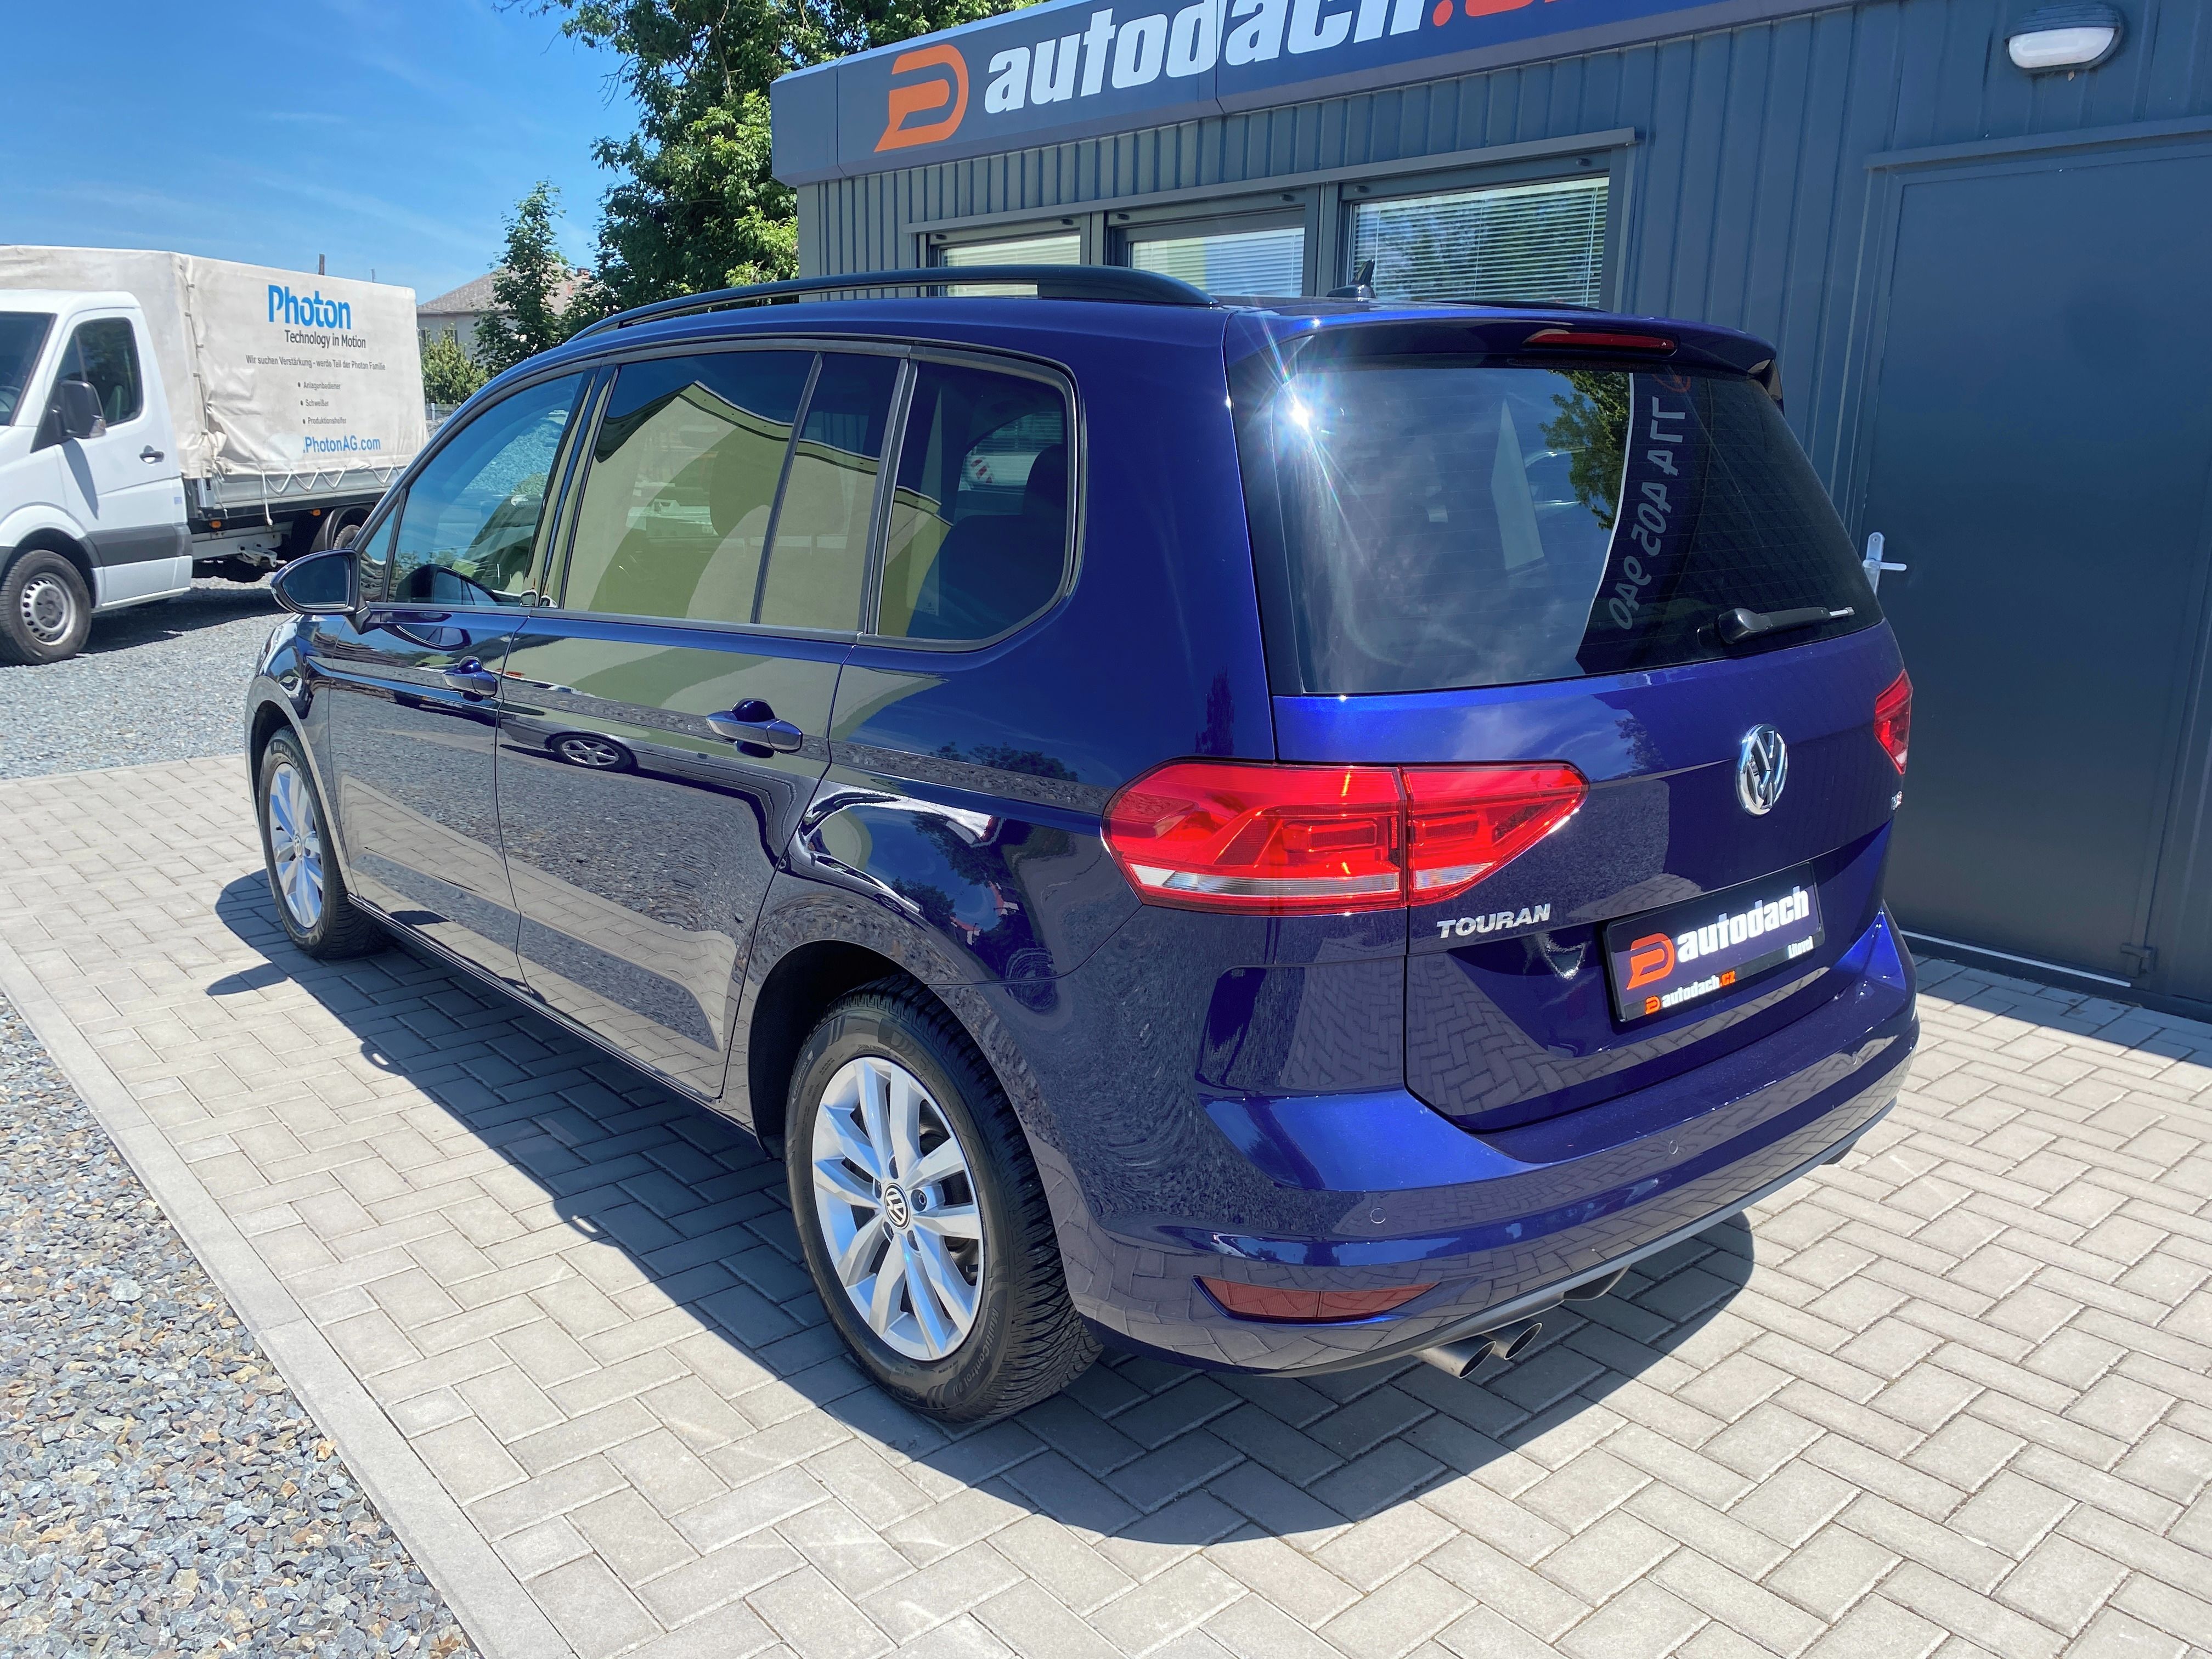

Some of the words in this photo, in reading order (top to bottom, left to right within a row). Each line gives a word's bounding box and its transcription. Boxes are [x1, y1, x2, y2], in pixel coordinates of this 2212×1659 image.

[268, 284, 351, 330] Photon
[285, 329, 330, 348] Technology
[332, 333, 339, 346] in
[341, 334, 366, 348] Motion
[246, 355, 256, 364] Wir
[258, 356, 279, 365] suchen
[279, 356, 312, 369] Verstärkung
[316, 359, 332, 368] werde
[332, 360, 341, 368] Teil
[342, 360, 351, 369] der
[351, 361, 368, 370] Photon
[369, 362, 386, 370] Familie
[303, 381, 341, 390] Anlagenbediener
[1436, 903, 1551, 939] TOURAN
[1677, 885, 1810, 963] autodach
[1662, 970, 1736, 1008] autodach.cz
